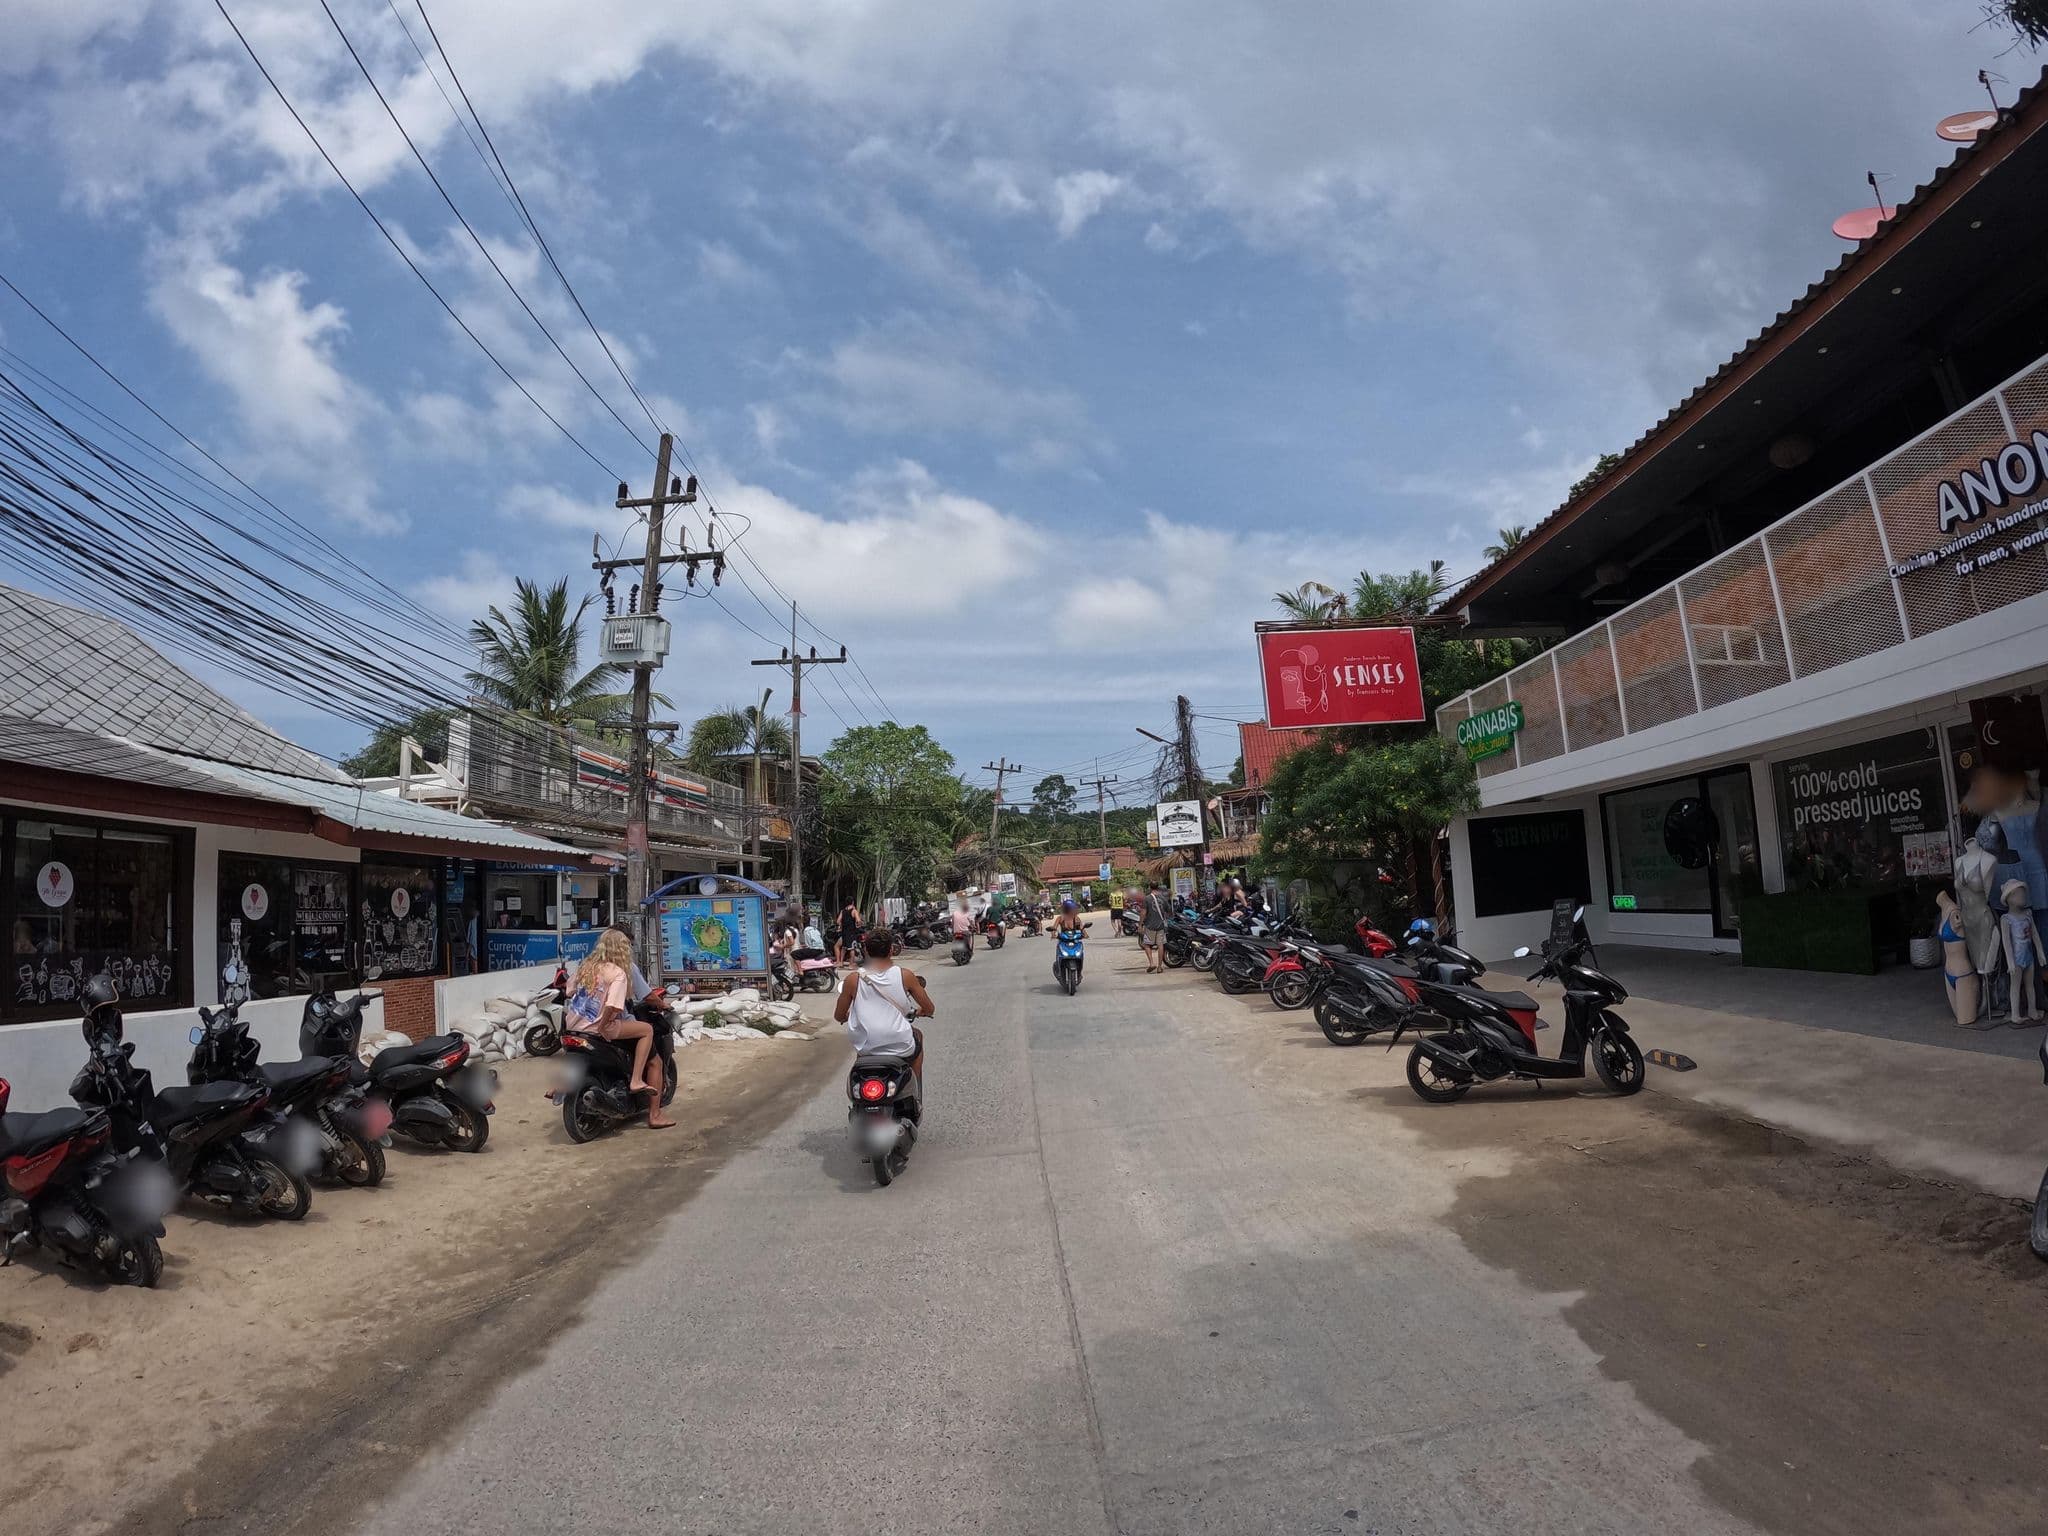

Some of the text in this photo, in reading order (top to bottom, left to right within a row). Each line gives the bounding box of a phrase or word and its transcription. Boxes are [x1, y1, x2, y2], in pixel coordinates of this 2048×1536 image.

[1955, 560, 1975, 576] for
[1977, 547, 2009, 567] men,
[1333, 662, 1405, 687] SENSES
[1457, 704, 1518, 745] CANNABIS
[1790, 759, 1879, 799] 100% cold
[1794, 788, 1923, 831] pressed juices
[1113, 896, 1122, 905] 12
[1614, 897, 1634, 908] OPEN
[487, 940, 527, 955] Currency
